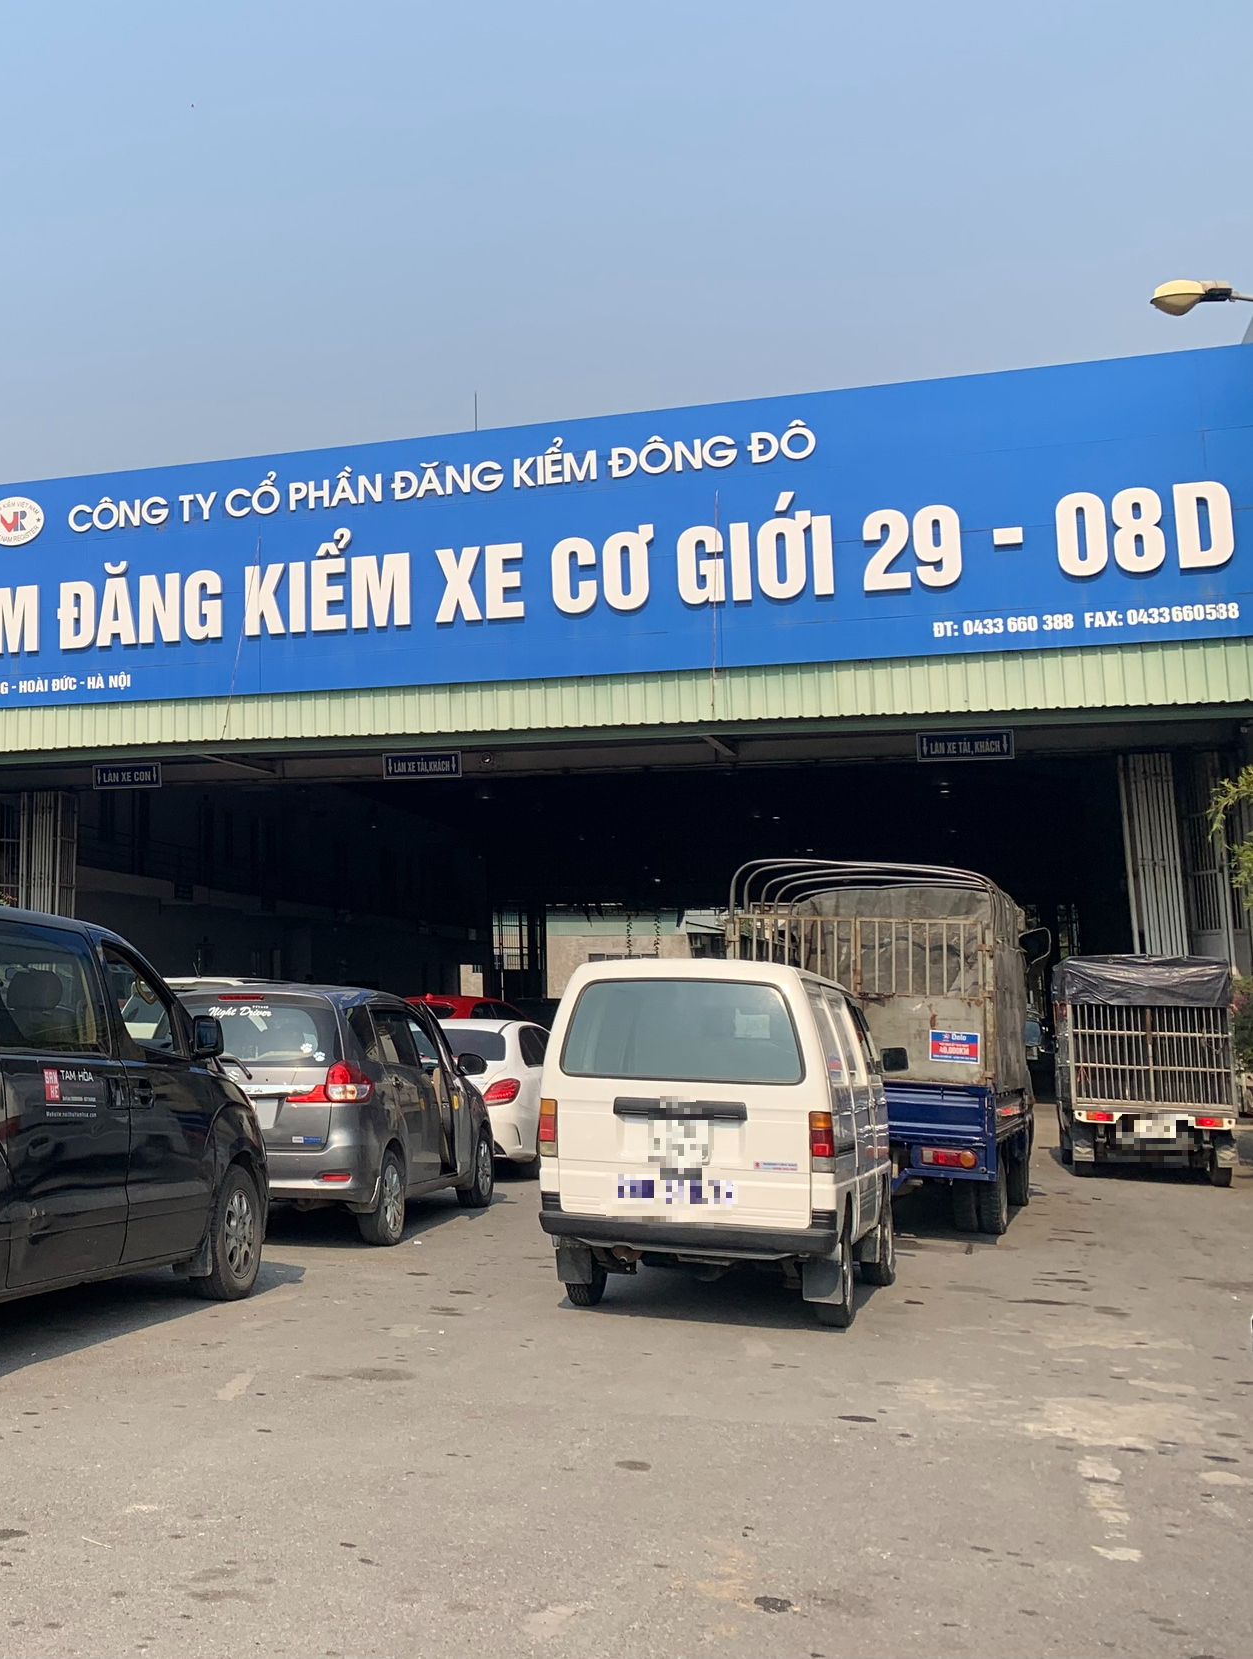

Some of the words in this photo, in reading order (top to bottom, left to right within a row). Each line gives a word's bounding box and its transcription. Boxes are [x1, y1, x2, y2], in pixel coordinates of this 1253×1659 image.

[69, 496, 169, 531] CÔNG
[179, 492, 217, 522] TY
[225, 471, 281, 517] CỔ
[290, 465, 382, 511] PHẦN
[391, 461, 504, 500] ĐĂNG
[514, 437, 598, 490] KIỂM
[608, 435, 738, 479] ĐÔNG
[748, 419, 816, 463] ĐÔ
[57, 561, 223, 650] ĐĂNG
[245, 527, 411, 636] KIỂM
[435, 543, 525, 623] XE
[552, 524, 654, 614] CƠ
[677, 491, 835, 605] GIỚI
[862, 504, 962, 592] 29
[1055, 481, 1235, 577] 08D
[933, 621, 959, 638] ĐT:
[963, 617, 1004, 636] 0433
[1007, 615, 1039, 633] 660
[1043, 613, 1074, 631] 388
[1085, 610, 1123, 629] FAX:
[19, 676, 49, 693] HOÀI
[51, 674, 77, 692] ĐỨC
[87, 673, 105, 690] HÀ
[109, 671, 131, 690] NỘI
[947, 742, 956, 754] XE
[407, 761, 415, 772] XE
[103, 770, 119, 782] LÀN
[121, 771, 132, 782] XE
[133, 771, 150, 782] CON
[208, 1006, 237, 1019] Night
[239, 1006, 272, 1017] Driver
[60, 1069, 76, 1081] TAM
